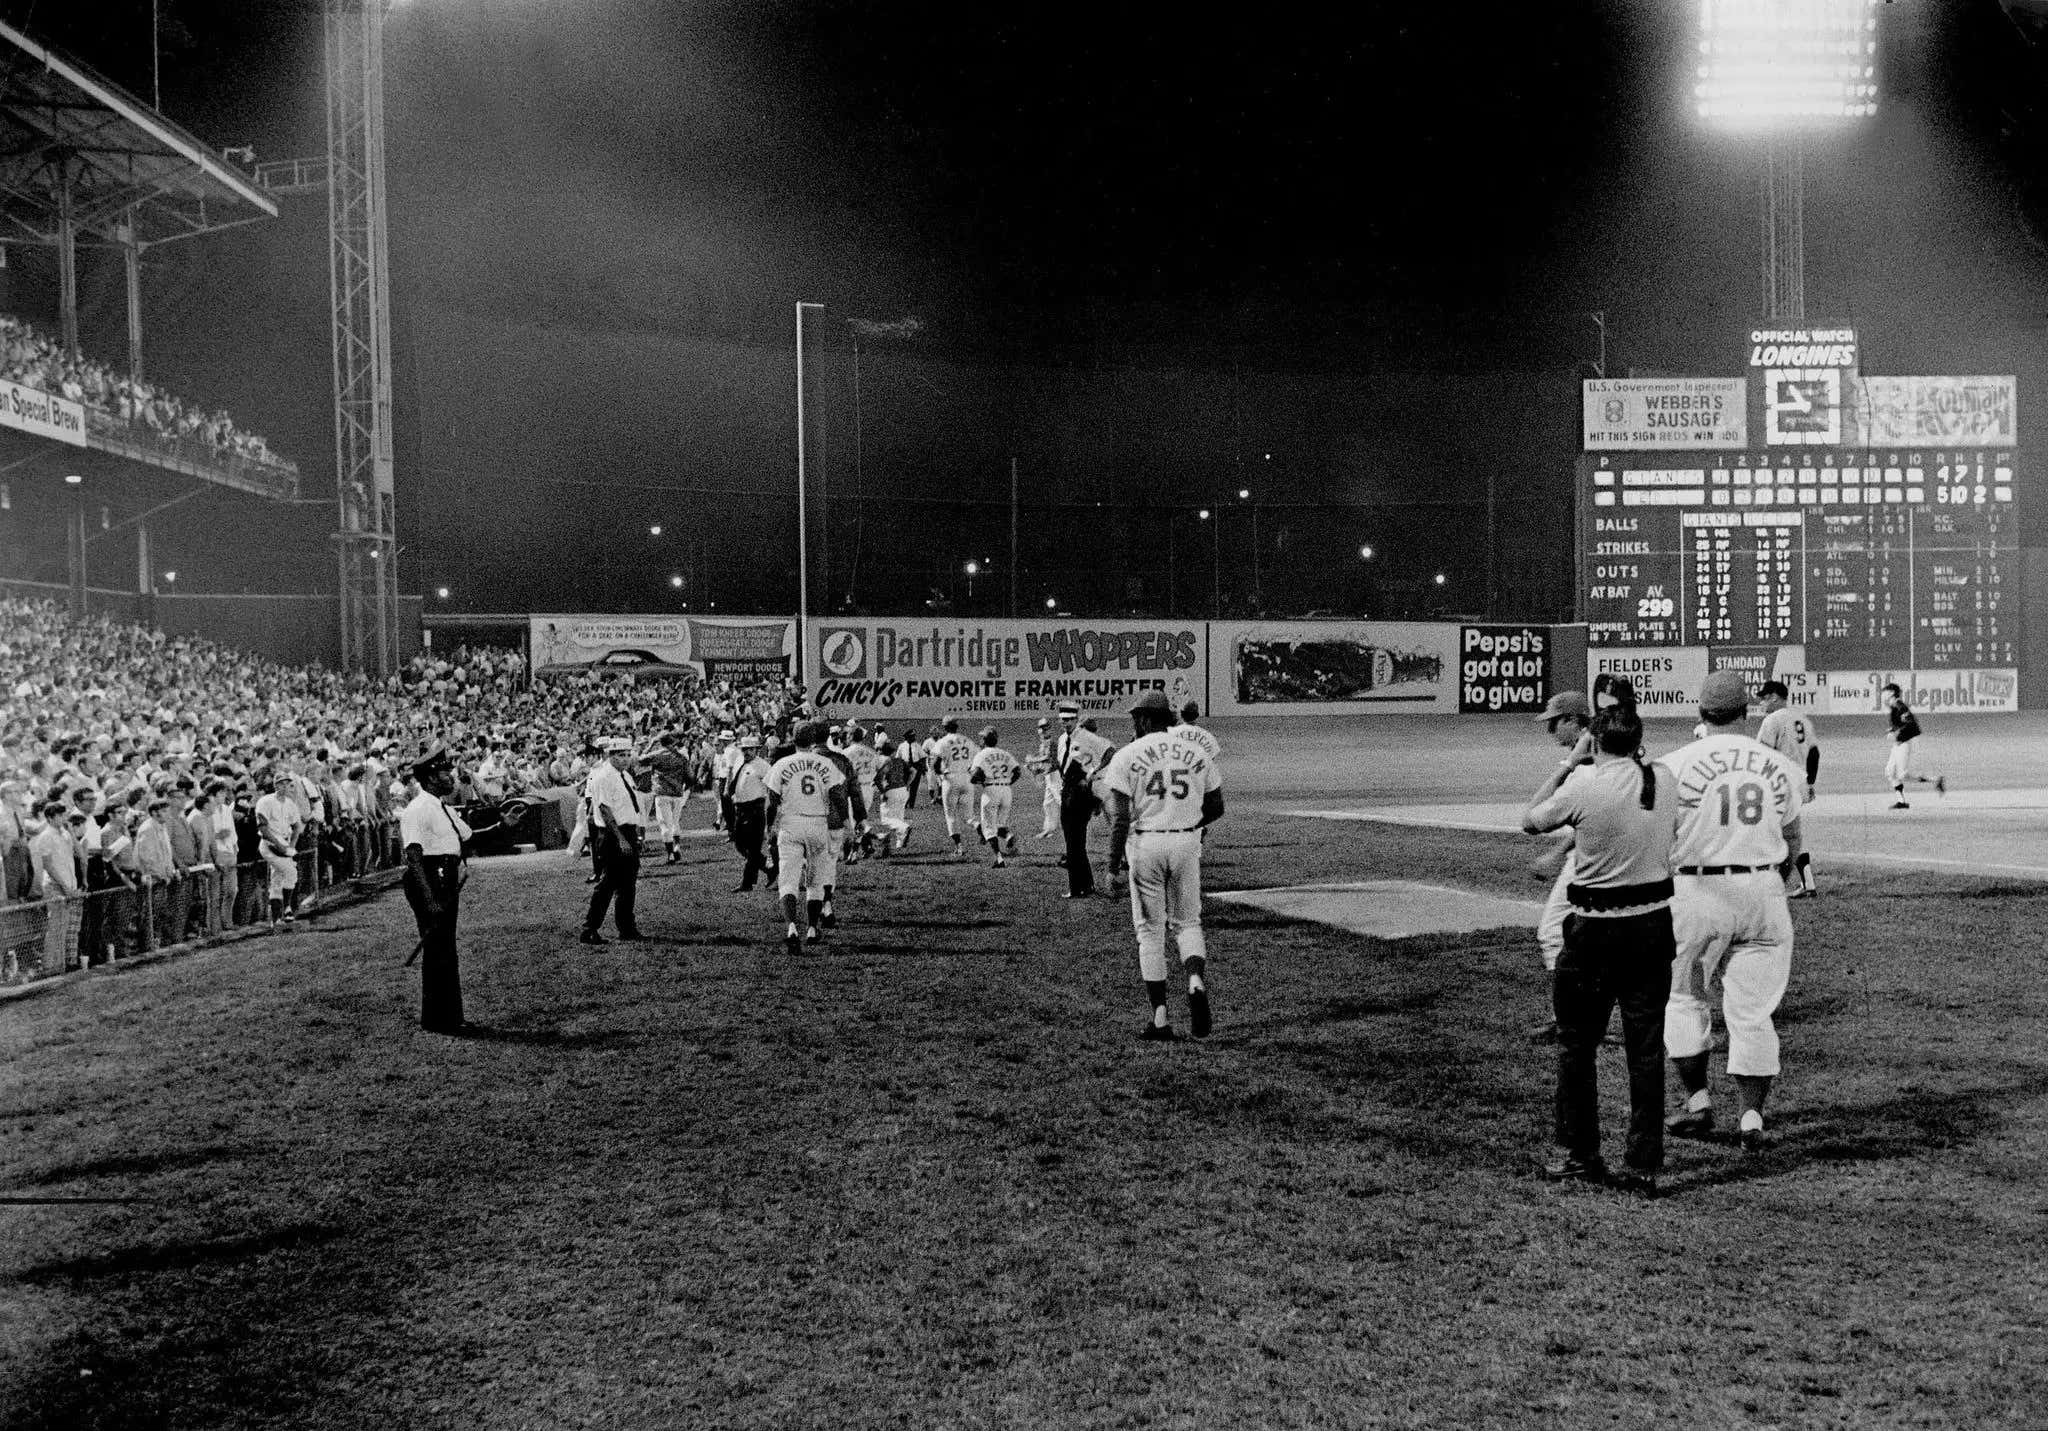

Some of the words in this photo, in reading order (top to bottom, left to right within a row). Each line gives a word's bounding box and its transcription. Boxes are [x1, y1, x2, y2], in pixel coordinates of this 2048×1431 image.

[1751, 330, 1809, 342] OFFICIAL
[1812, 329, 1853, 342] WATCH
[1750, 345, 1856, 366] LONGINES
[1589, 382, 1610, 392] U.S.
[1614, 381, 1679, 392] Government
[12, 387, 51, 425] Special
[52, 400, 79, 432] Brew
[1590, 432, 1604, 441] HIT
[1609, 432, 1628, 441] THIS
[1633, 432, 1656, 441] SIGN
[1694, 432, 1713, 441] WIN
[1600, 456, 1609, 467] P
[1718, 455, 1723, 467] 1
[1738, 455, 1746, 466] 2
[1760, 455, 1768, 466] 3
[1782, 455, 1791, 466] 4
[1803, 455, 1811, 466] 5
[1825, 455, 1833, 466] 6
[1847, 455, 1854, 465] 7
[1868, 454, 1876, 465] 8
[1890, 454, 1898, 465] 9
[1909, 454, 1921, 465] 10
[1937, 453, 1945, 464] R
[1955, 453, 1963, 464] H
[1977, 453, 1984, 464] E
[1937, 466, 1949, 482] 4
[1955, 465, 1968, 483] 7
[1977, 465, 1983, 483] 1
[1938, 486, 1948, 503] 5
[1951, 485, 1967, 503] 10
[1974, 485, 1986, 503] 2
[1596, 518, 1638, 531] BALLS
[1882, 526, 1894, 534] 10
[1597, 541, 1649, 554] STRIKES
[1758, 540, 1770, 549] 14
[1597, 565, 1638, 578] OUTS
[1697, 562, 1710, 573] 24
[1882, 568, 1889, 576] 0
[1590, 586, 1606, 599] AT
[1607, 586, 1631, 599] BAT
[1647, 585, 1664, 598] AV.
[1638, 599, 1673, 617] 299
[1697, 607, 1710, 617] 47
[1720, 607, 1727, 617] P
[1868, 603, 1875, 611] 0
[1589, 622, 1628, 632] UMPIRES
[1639, 622, 1664, 631] PLATE
[1603, 632, 1610, 641] 7
[1634, 632, 1646, 641] 14
[1699, 630, 1710, 640] 17
[1780, 629, 1787, 639] P
[1465, 629, 1543, 656] Pepsi's
[877, 627, 1019, 678] Partridge
[1026, 628, 1196, 674] WHOPPERS
[714, 663, 753, 672] NEWPORT
[756, 663, 782, 672] DODGE
[1464, 657, 1498, 682] got
[1501, 660, 1514, 677] a
[1518, 656, 1543, 677] lot
[1600, 657, 1673, 672] FIELDER'S
[1716, 656, 1766, 669] STANDARD
[1781, 673, 1806, 686] IT'S
[1817, 674, 1826, 686] A
[815, 679, 903, 707] CINCY'S
[907, 681, 1006, 697] FAVORITE
[1464, 683, 1485, 703] to
[1489, 680, 1542, 710] give!
[1834, 686, 1860, 698] Have
[1863, 689, 1869, 698] a
[1869, 672, 1974, 711] Hdepohl
[1014, 699, 1039, 710] HERE
[1792, 692, 1816, 705] HIT
[1794, 720, 1805, 743] 9
[952, 746, 969, 760] 23
[1131, 742, 1205, 776] SIMPSON
[802, 775, 815, 795] 6
[1146, 769, 1189, 800] 45
[1678, 749, 1788, 815] KLUSZEWSKI
[1717, 783, 1763, 825] 18
